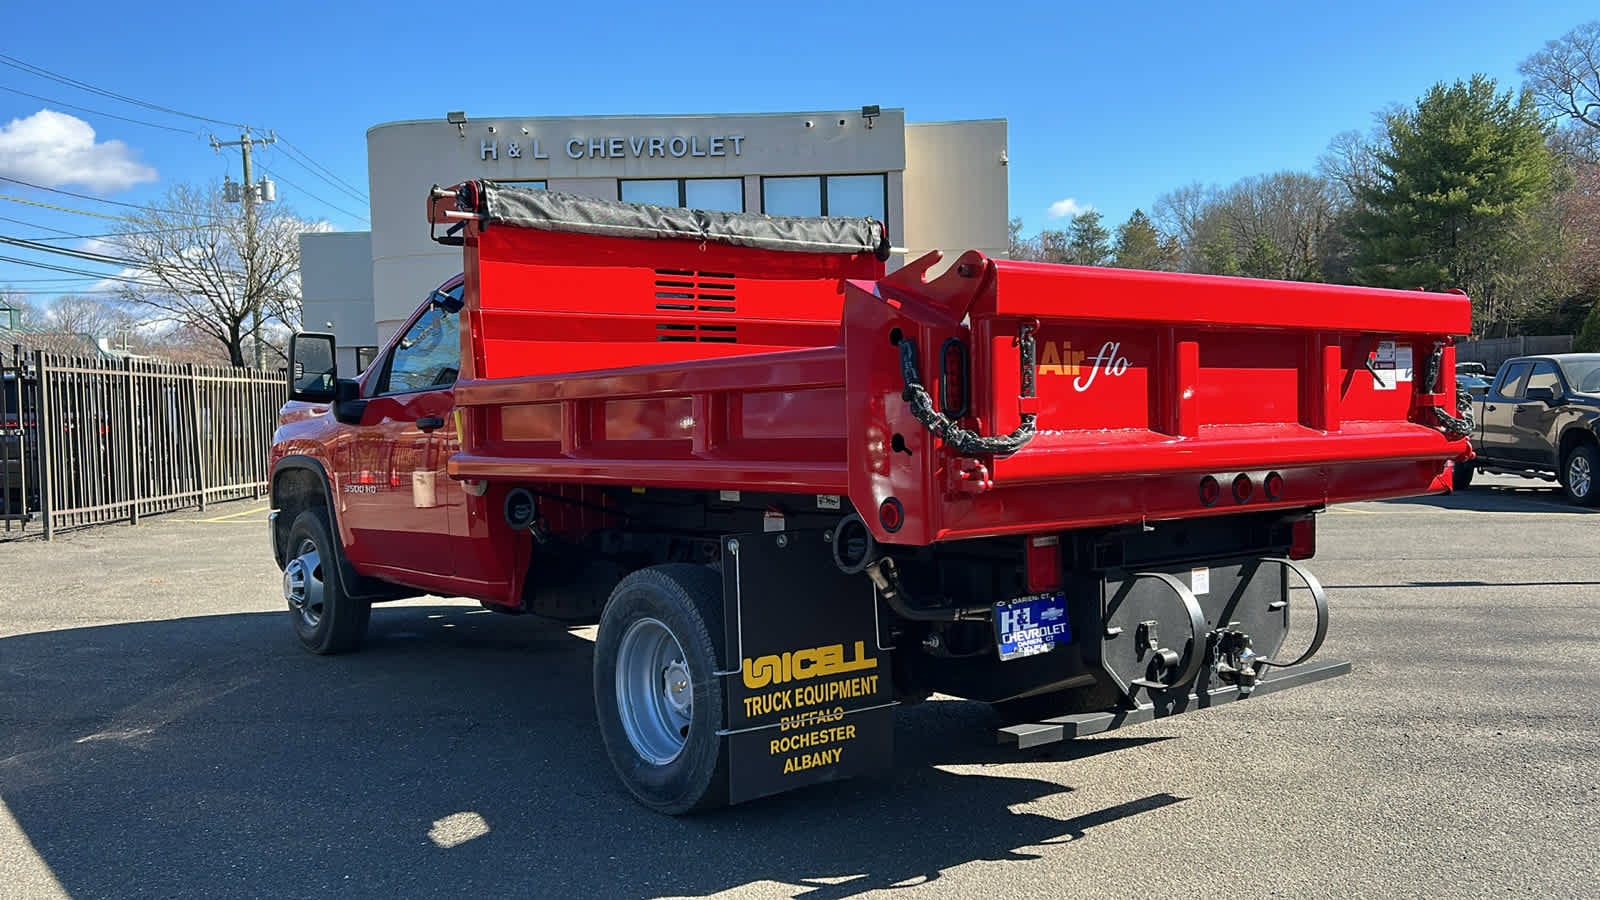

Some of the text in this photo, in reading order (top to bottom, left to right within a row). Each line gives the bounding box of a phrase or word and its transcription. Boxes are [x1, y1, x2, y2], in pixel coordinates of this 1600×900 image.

[480, 135, 745, 160] H & L CHEVROLET
[1038, 341, 1085, 375] Air
[344, 485, 377, 494] 3500 HD
[1000, 607, 1038, 633] H&L
[1002, 622, 1066, 644] CHEVROLET
[742, 640, 878, 689] UNICELL
[744, 675, 879, 718] TRUCK EQUIPMENT
[780, 706, 844, 732] BUFFALO
[770, 724, 857, 755] ROCHESTER
[783, 747, 844, 775] ALBANY
